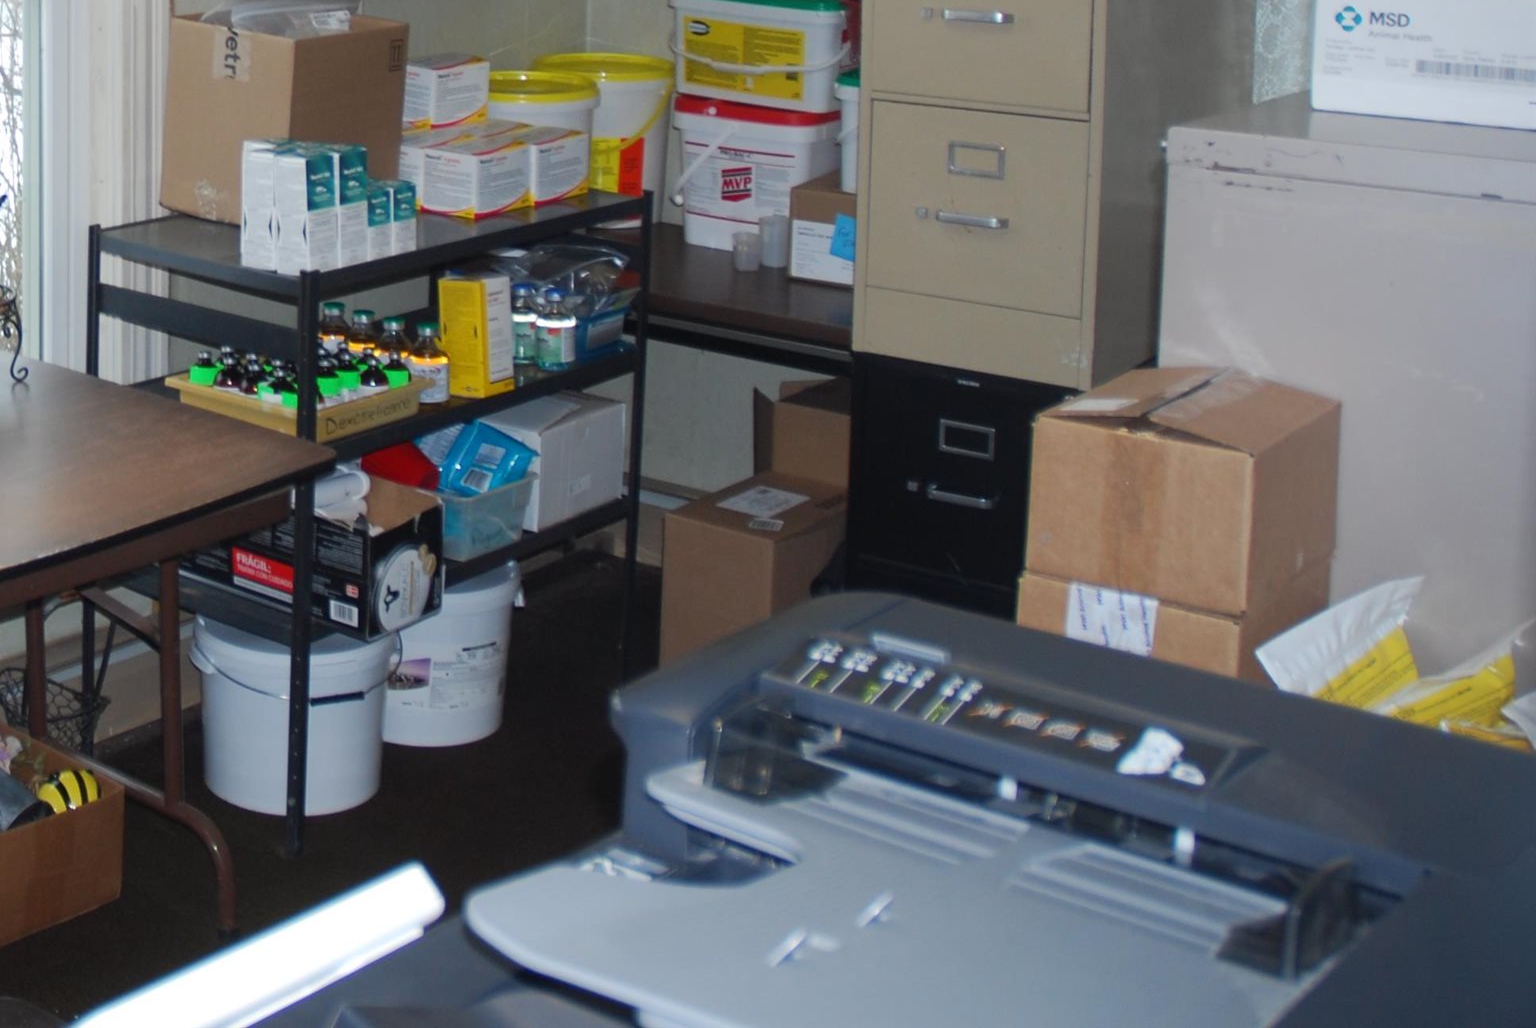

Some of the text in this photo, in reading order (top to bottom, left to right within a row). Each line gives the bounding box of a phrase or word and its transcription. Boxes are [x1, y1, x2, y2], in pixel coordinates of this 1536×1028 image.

[1369, 11, 1410, 28] MSD
[1368, 30, 1433, 43] Animal Health
[223, 24, 241, 80] vetr
[721, 177, 752, 191] MVP
